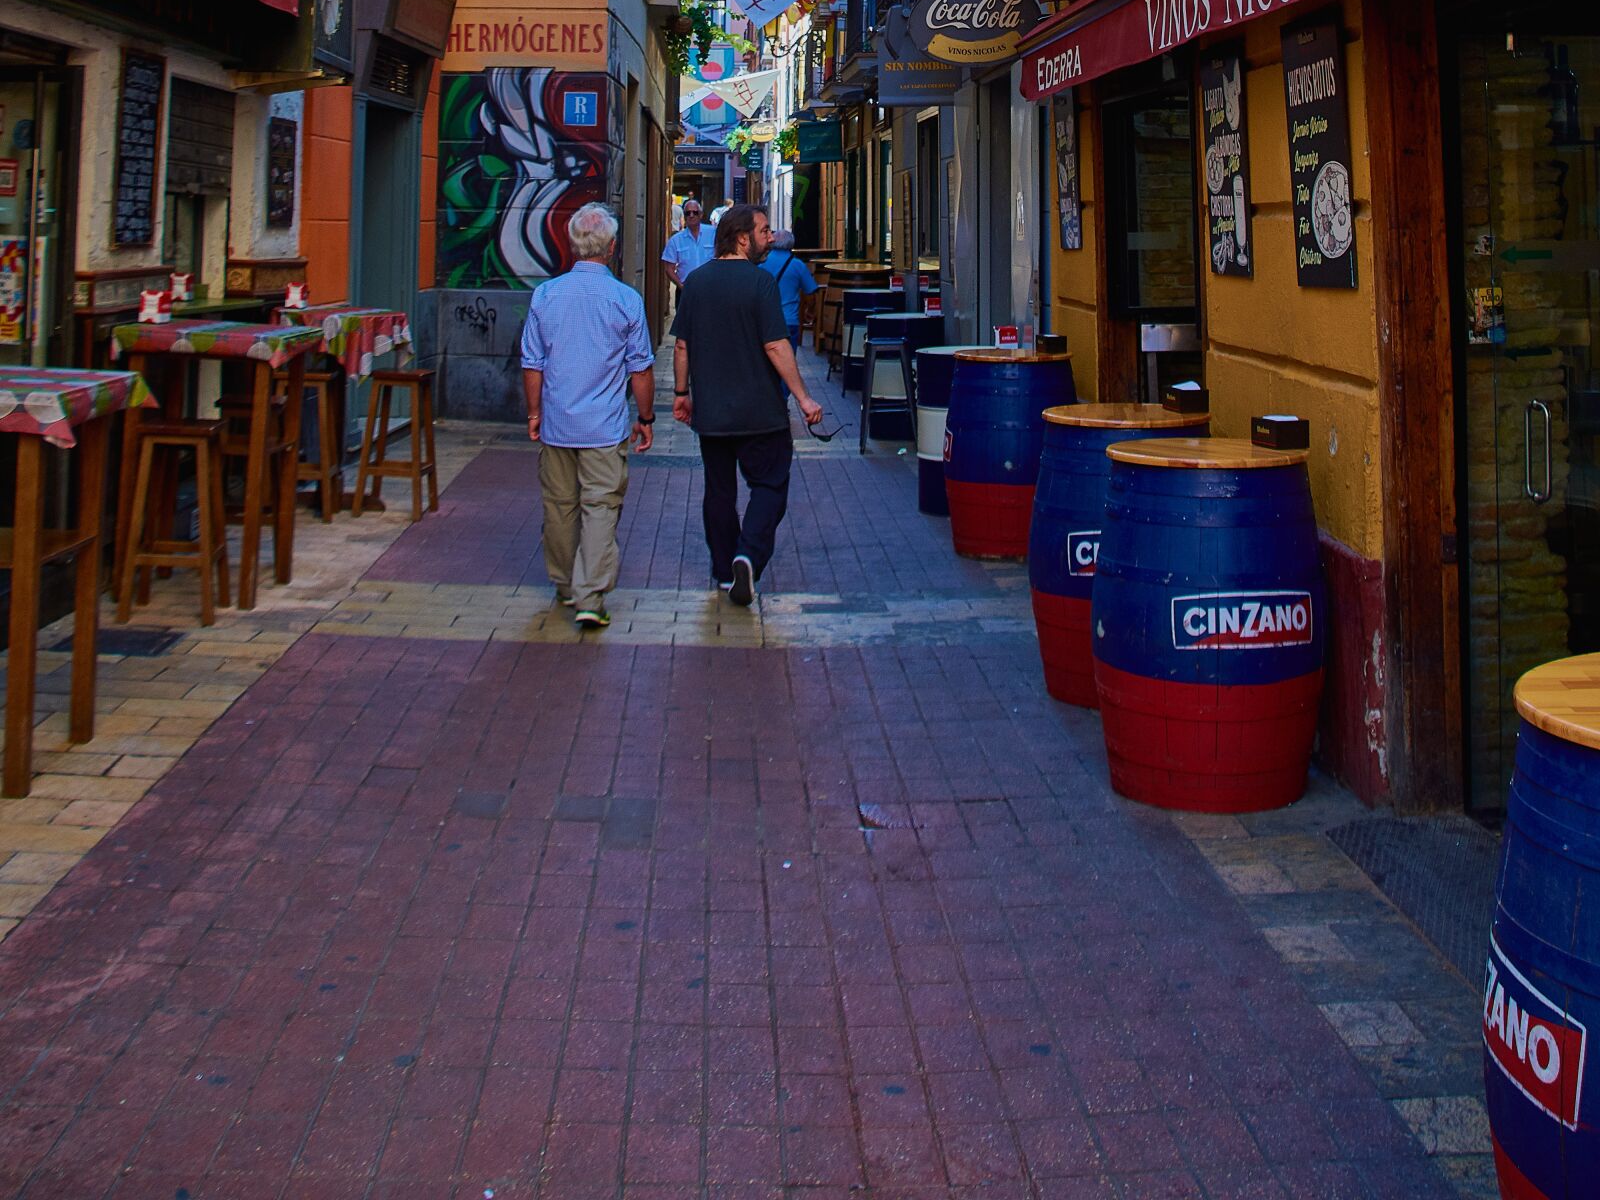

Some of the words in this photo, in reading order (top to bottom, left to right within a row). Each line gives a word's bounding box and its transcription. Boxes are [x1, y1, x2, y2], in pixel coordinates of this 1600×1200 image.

[447, 16, 604, 53] HERMÓGENES
[948, 47, 972, 56] VINOS
[972, 44, 1007, 56] NICOLAS
[884, 62, 904, 71] SIN
[1037, 45, 1082, 91] EDERRA
[1288, 64, 1313, 107] HUEVOS
[1312, 57, 1336, 100] ROTOS
[574, 96, 588, 114] R
[1182, 602, 1308, 638] CINZANO
